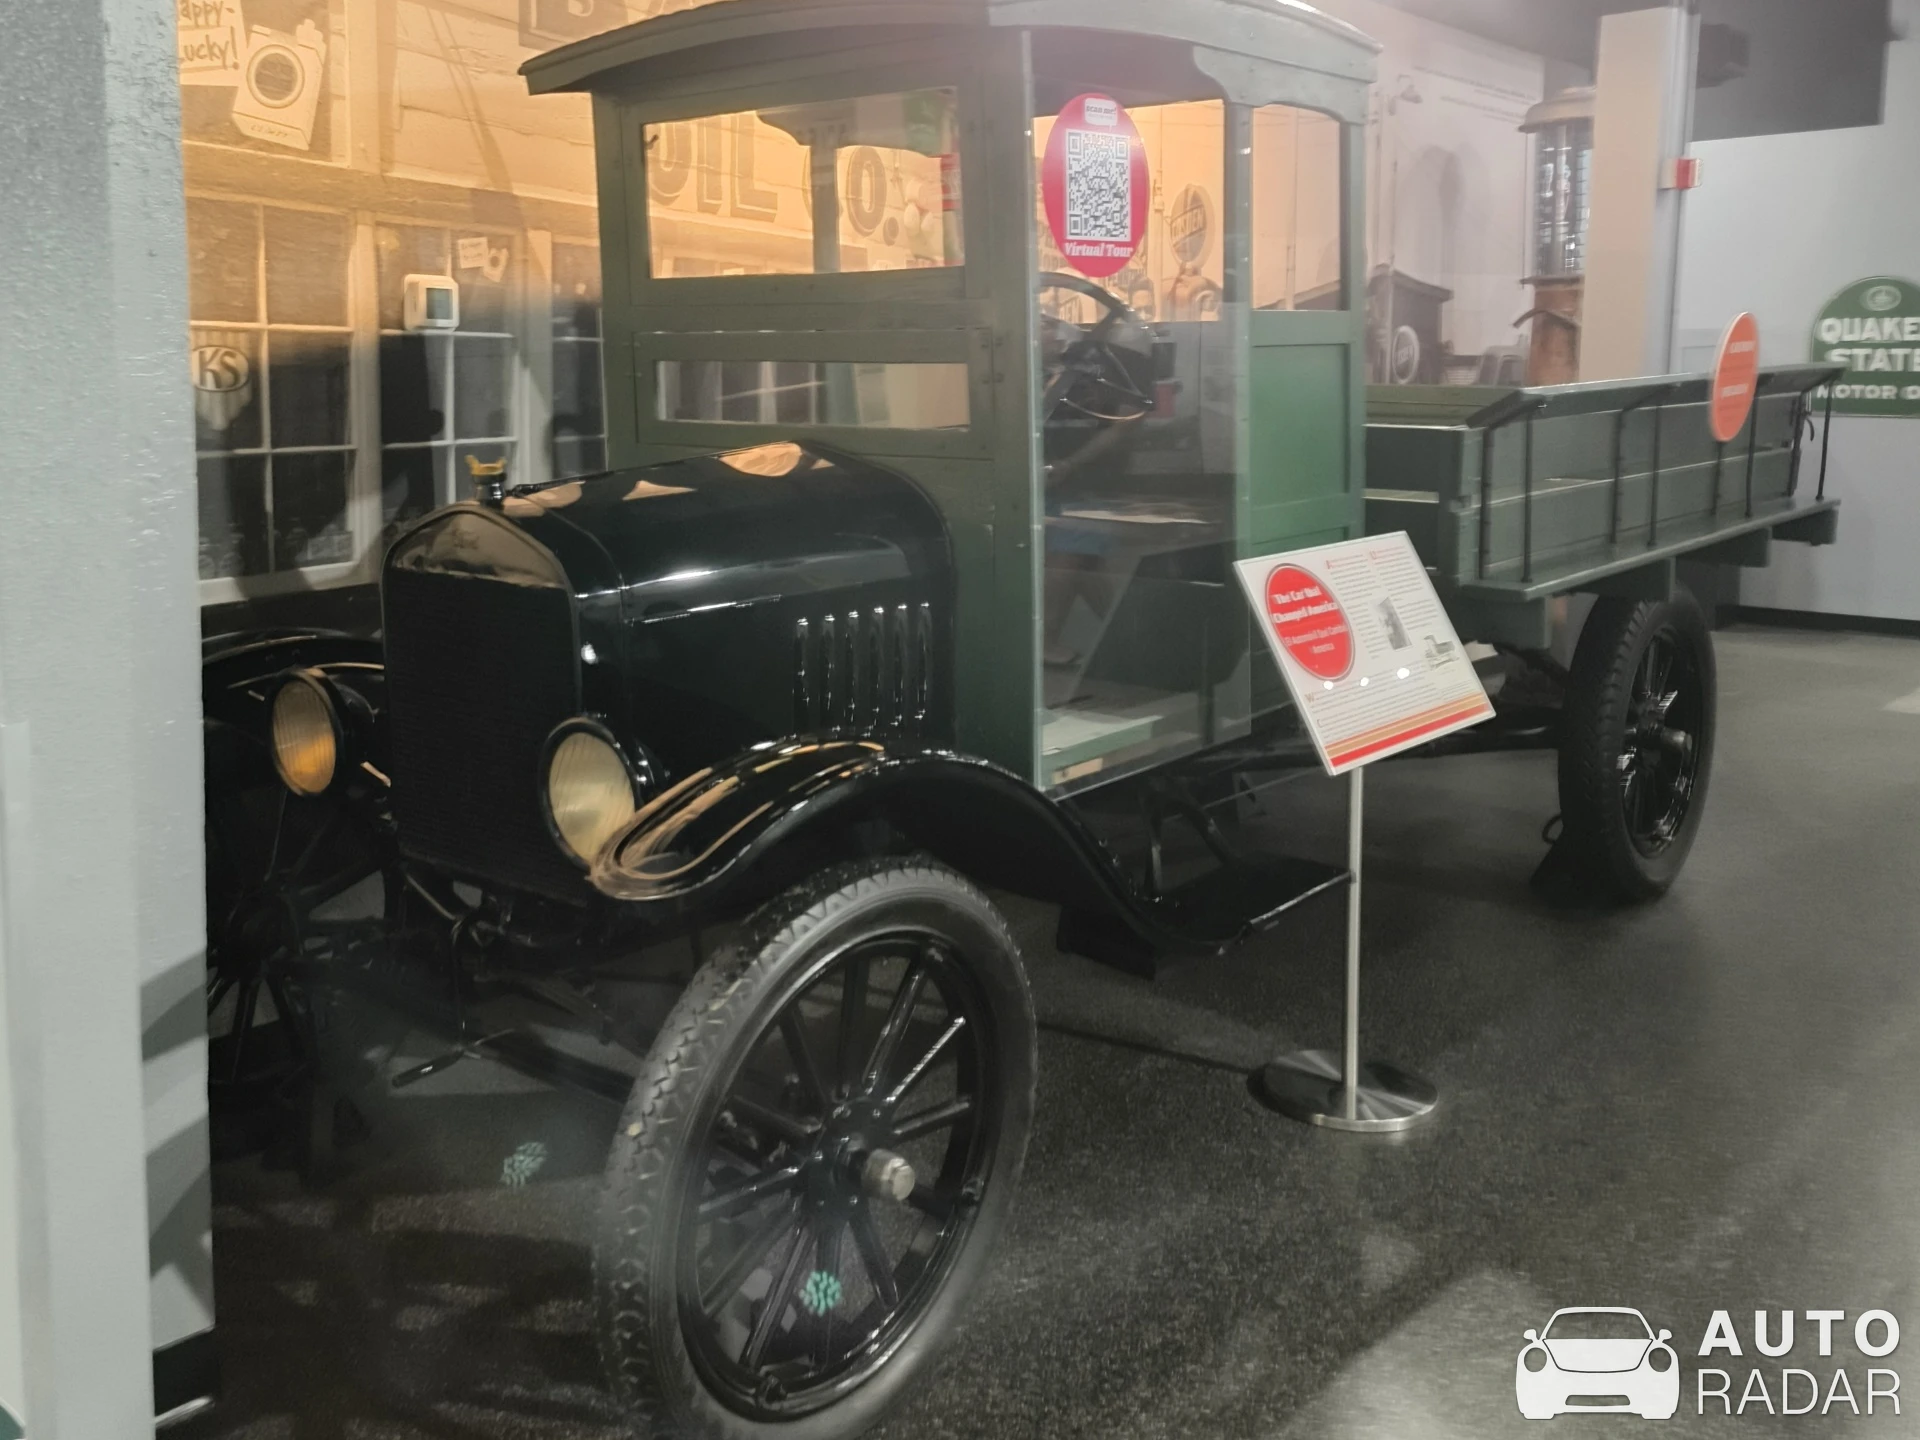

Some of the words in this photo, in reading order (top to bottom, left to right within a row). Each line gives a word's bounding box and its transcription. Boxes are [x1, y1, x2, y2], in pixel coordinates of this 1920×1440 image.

[180, 0, 235, 27] appy-
[177, 26, 239, 71] ucky!
[1064, 241, 1106, 257] Virtual
[1106, 244, 1134, 258] Tour
[1820, 316, 1920, 344] QUAKE
